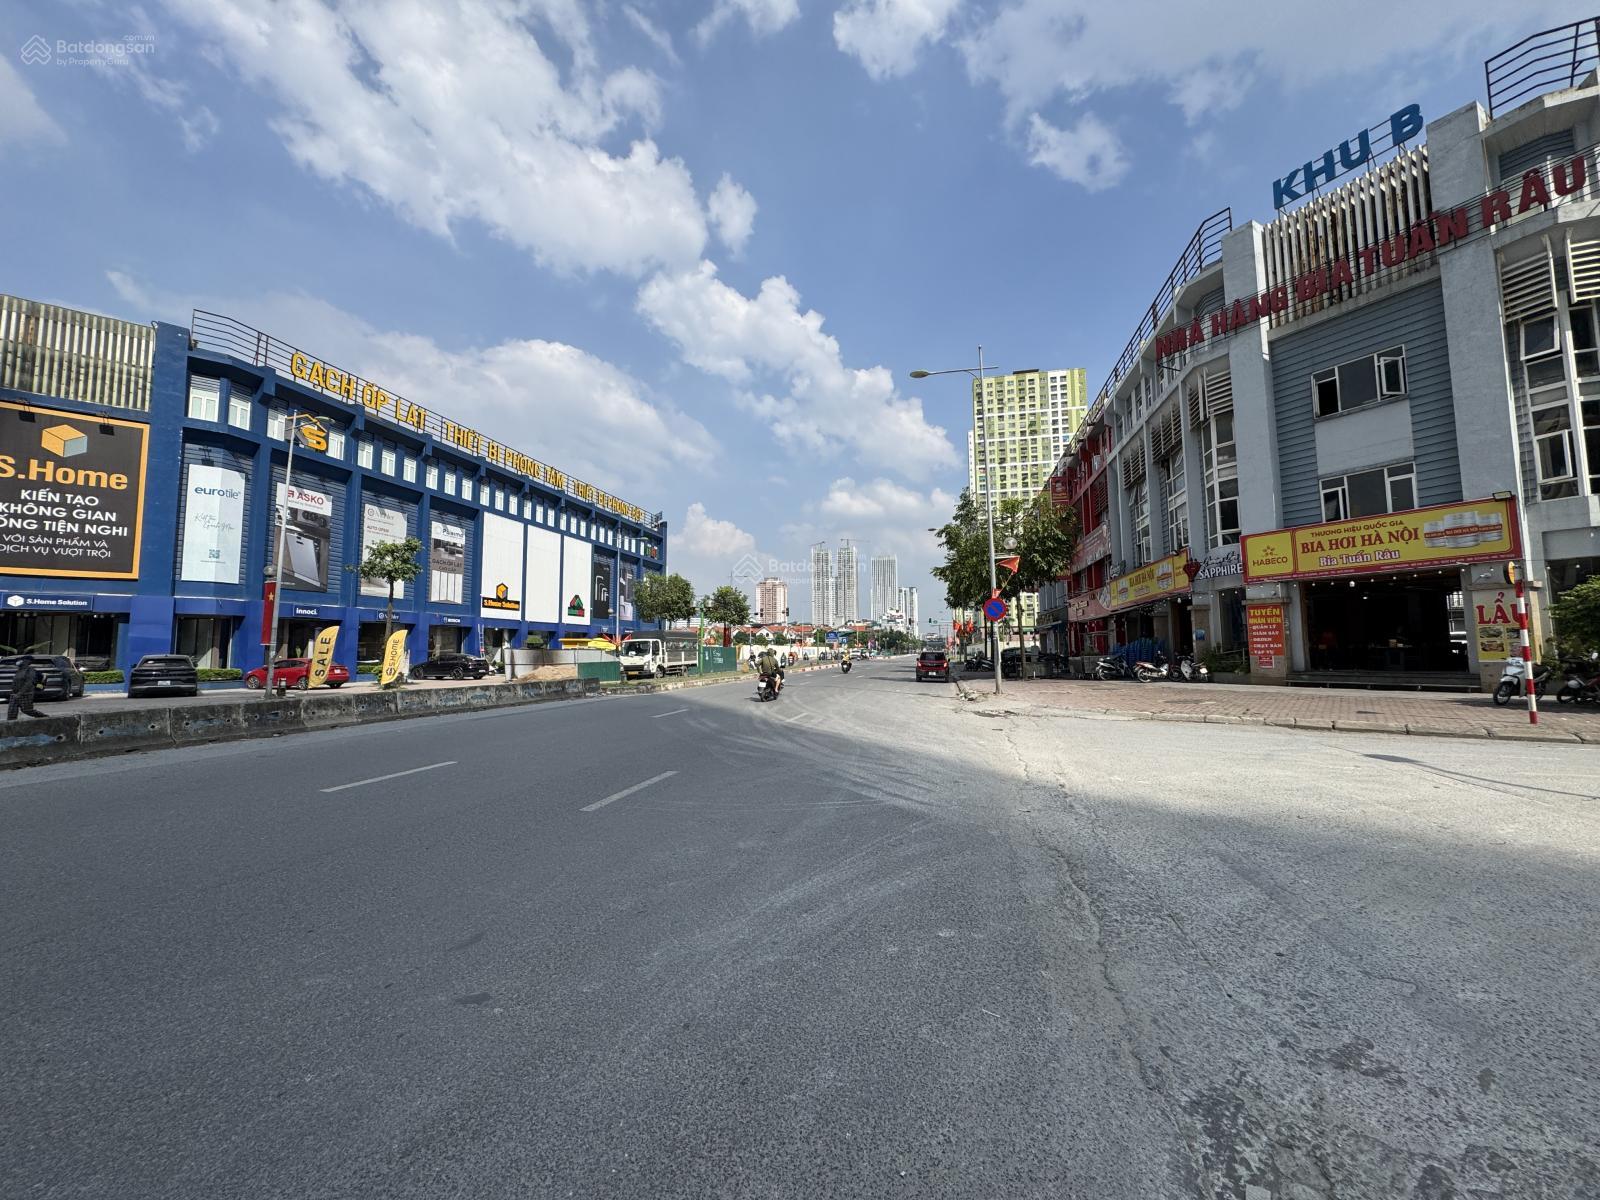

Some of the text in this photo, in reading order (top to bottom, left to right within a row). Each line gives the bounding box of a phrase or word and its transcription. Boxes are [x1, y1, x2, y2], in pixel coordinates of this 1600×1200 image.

[1273, 103, 1424, 210] KHU B
[1155, 155, 1586, 362] NHÀ HÀNG BIA TUẤN RÂU
[290, 351, 357, 401] GẠCH
[361, 381, 390, 412] ỐP
[444, 420, 484, 455] THIẾT
[0, 455, 128, 490] S.Home
[20, 488, 99, 508] KIẾN TẠO
[194, 485, 240, 500] eurotile
[297, 490, 325, 506] ASKO
[0, 502, 117, 522] KHÔNG GIAN
[43, 519, 79, 535] TIỆN
[84, 523, 128, 537] NGHI
[1363, 521, 1387, 531] QUỐC
[1389, 519, 1405, 527] GIA
[28, 534, 53, 545] SẢN
[93, 539, 109, 549] VÀ
[1301, 540, 1326, 554] BIA
[1359, 529, 1384, 547] HÀ
[1387, 526, 1421, 545] NỘI
[33, 546, 49, 556] VỤ
[52, 546, 84, 558] VƯỢT
[86, 549, 111, 560] TRỘI
[1252, 556, 1289, 567] HABECO
[1319, 555, 1338, 568] Bia
[1339, 550, 1372, 565] Tuấn
[1374, 548, 1401, 562] Râu
[1198, 562, 1244, 580] SAPPHIRE
[26, 598, 88, 607] S.Home Solution
[1475, 591, 1530, 626] LẨU
[314, 636, 332, 678] SALE
